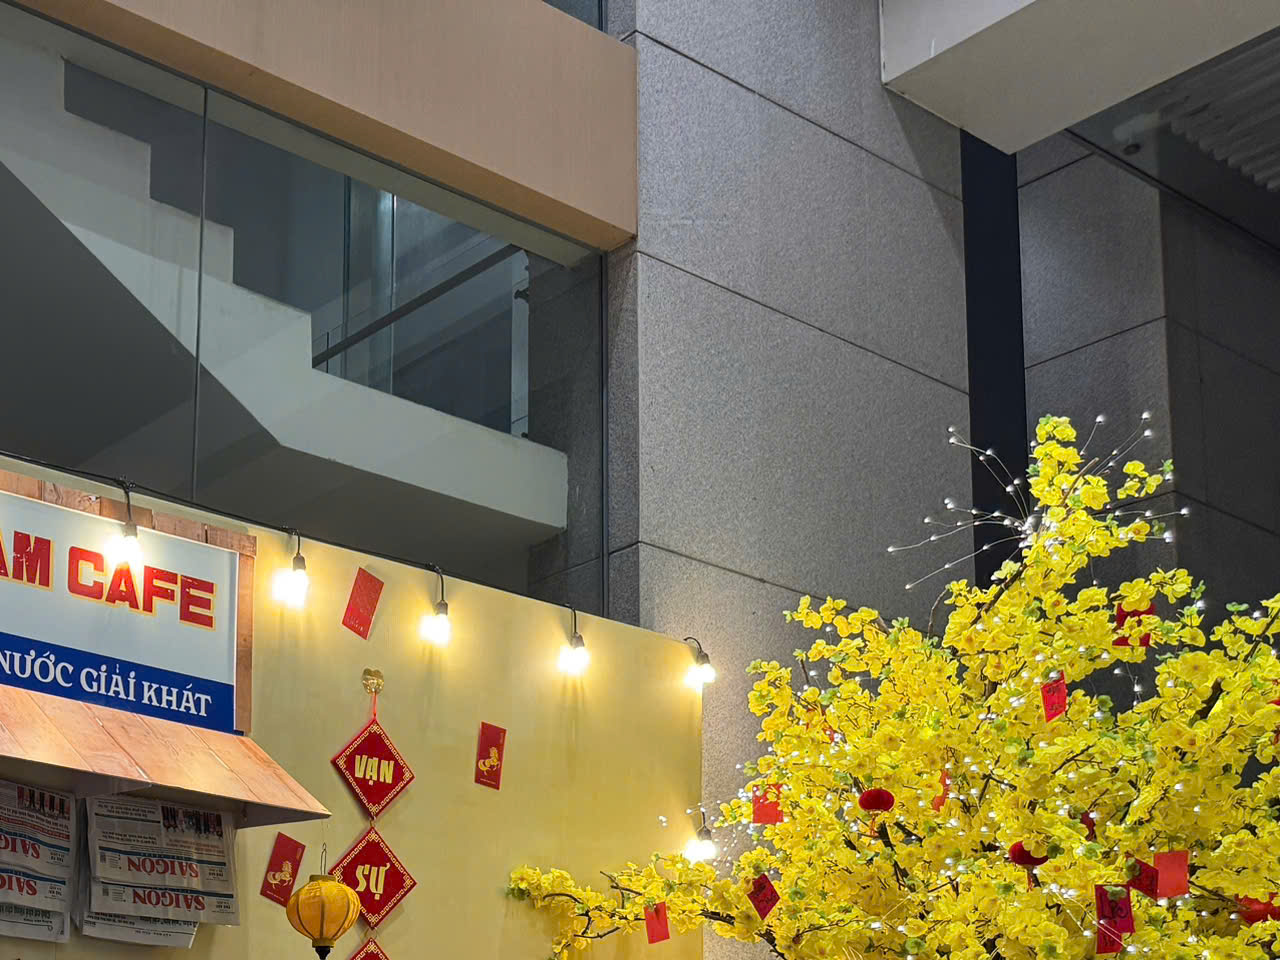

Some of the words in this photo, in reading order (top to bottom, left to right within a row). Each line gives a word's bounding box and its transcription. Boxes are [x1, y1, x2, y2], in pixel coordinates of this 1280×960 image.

[67, 544, 216, 630] CAFE
[141, 682, 212, 717] KHÁT
[354, 754, 395, 785] VẠN
[355, 862, 391, 901] SỰ
